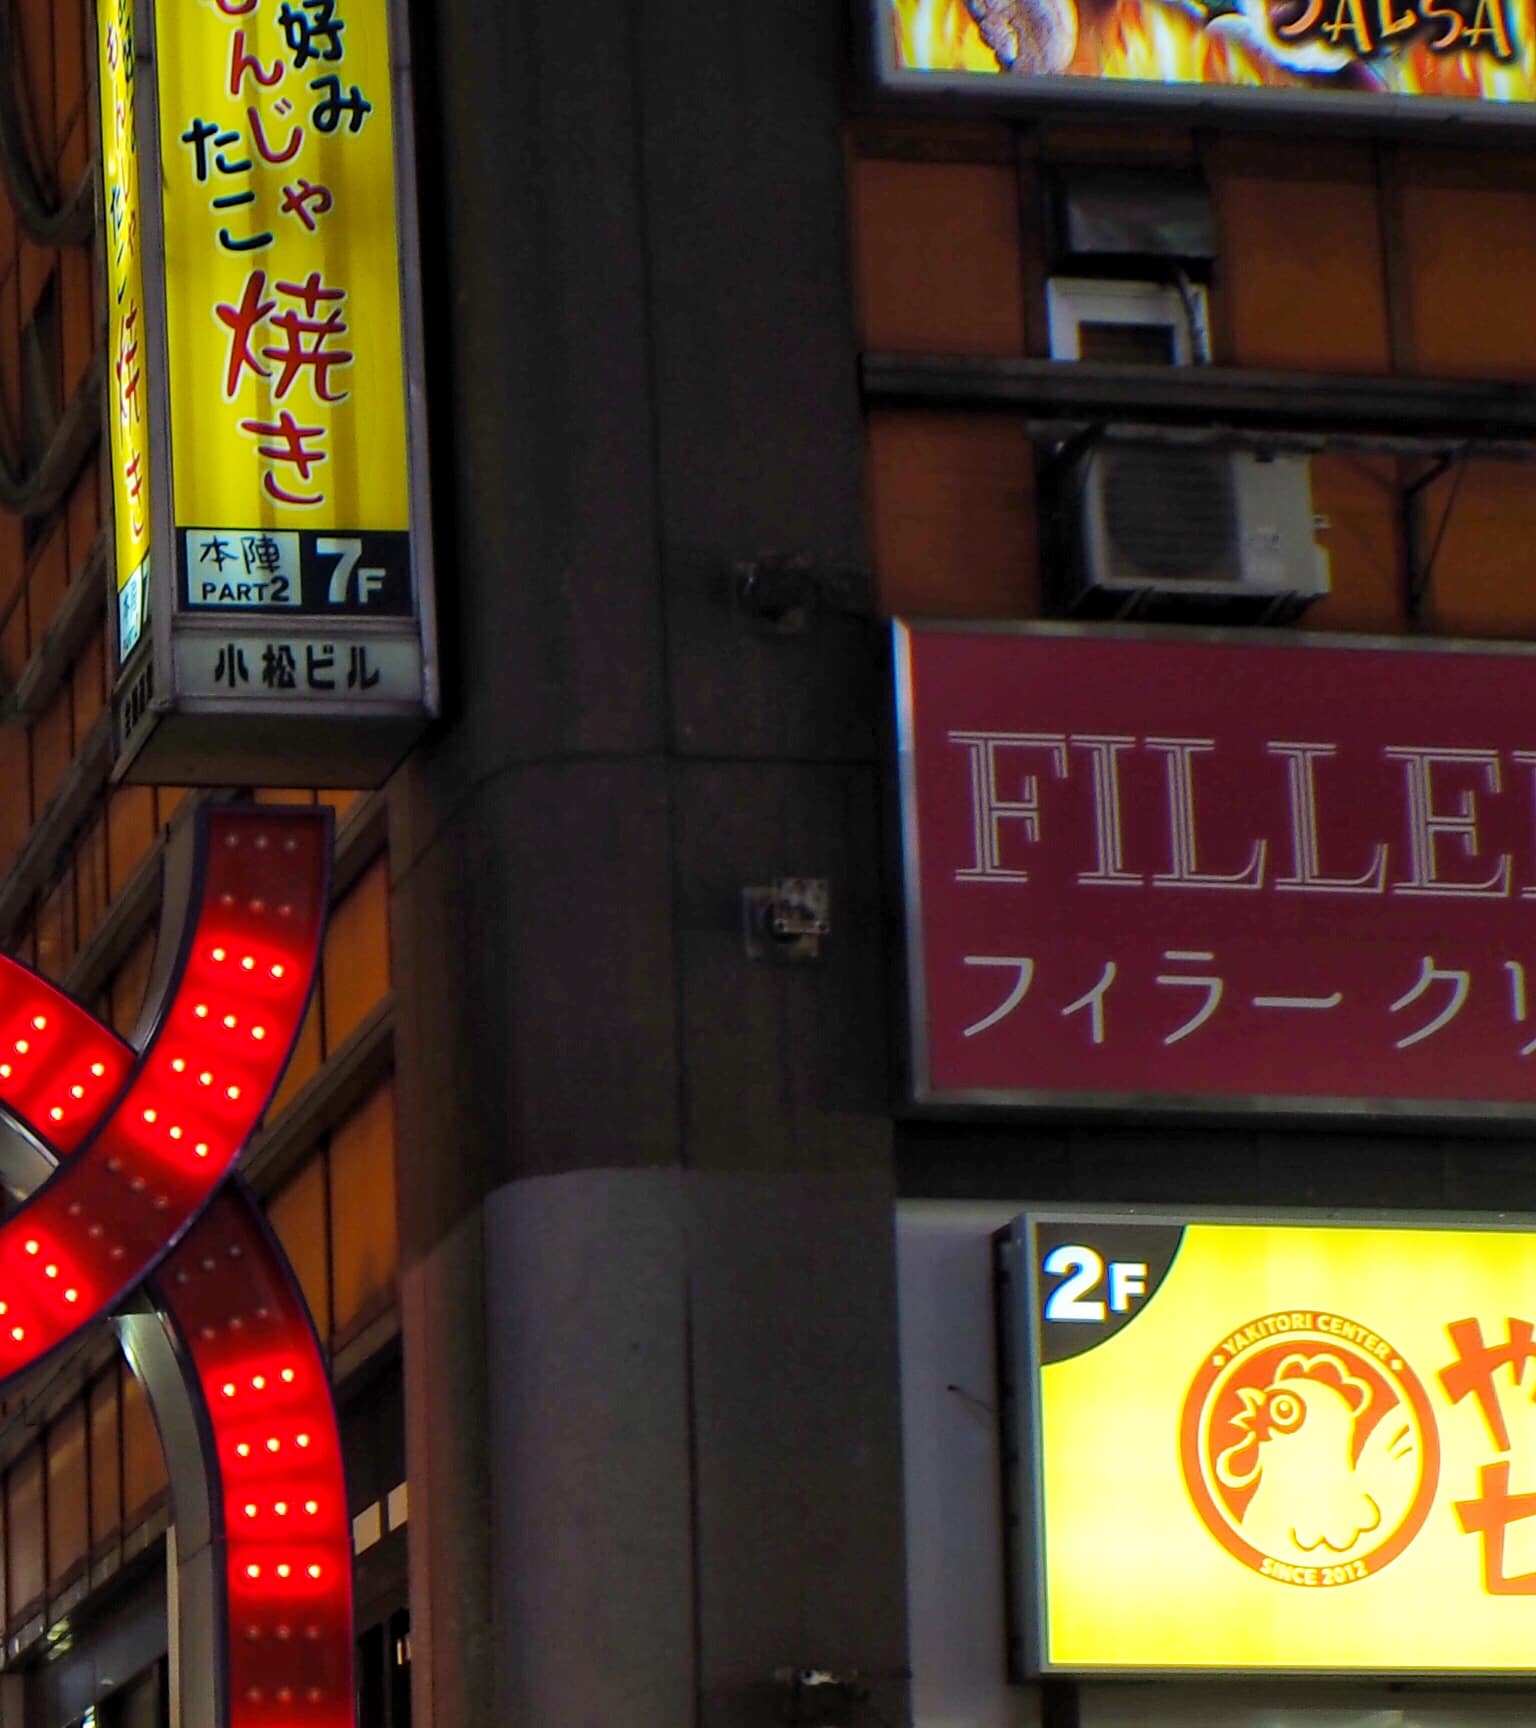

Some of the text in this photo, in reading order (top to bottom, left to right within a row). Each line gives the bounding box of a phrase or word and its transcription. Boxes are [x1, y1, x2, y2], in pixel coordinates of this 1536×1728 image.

[182, 117, 273, 252] たこ
[215, 271, 353, 505] 焼き
[199, 534, 282, 577] 本陣
[316, 538, 385, 603] 7F
[202, 574, 291, 603] PART2
[213, 643, 380, 691] 小松ビル
[948, 730, 1536, 899] FILLE
[1043, 1245, 1147, 1322] 2F
[1220, 1313, 1390, 1360] YAKITORI CENTER
[1260, 1557, 1367, 1585] SINCE 2012
